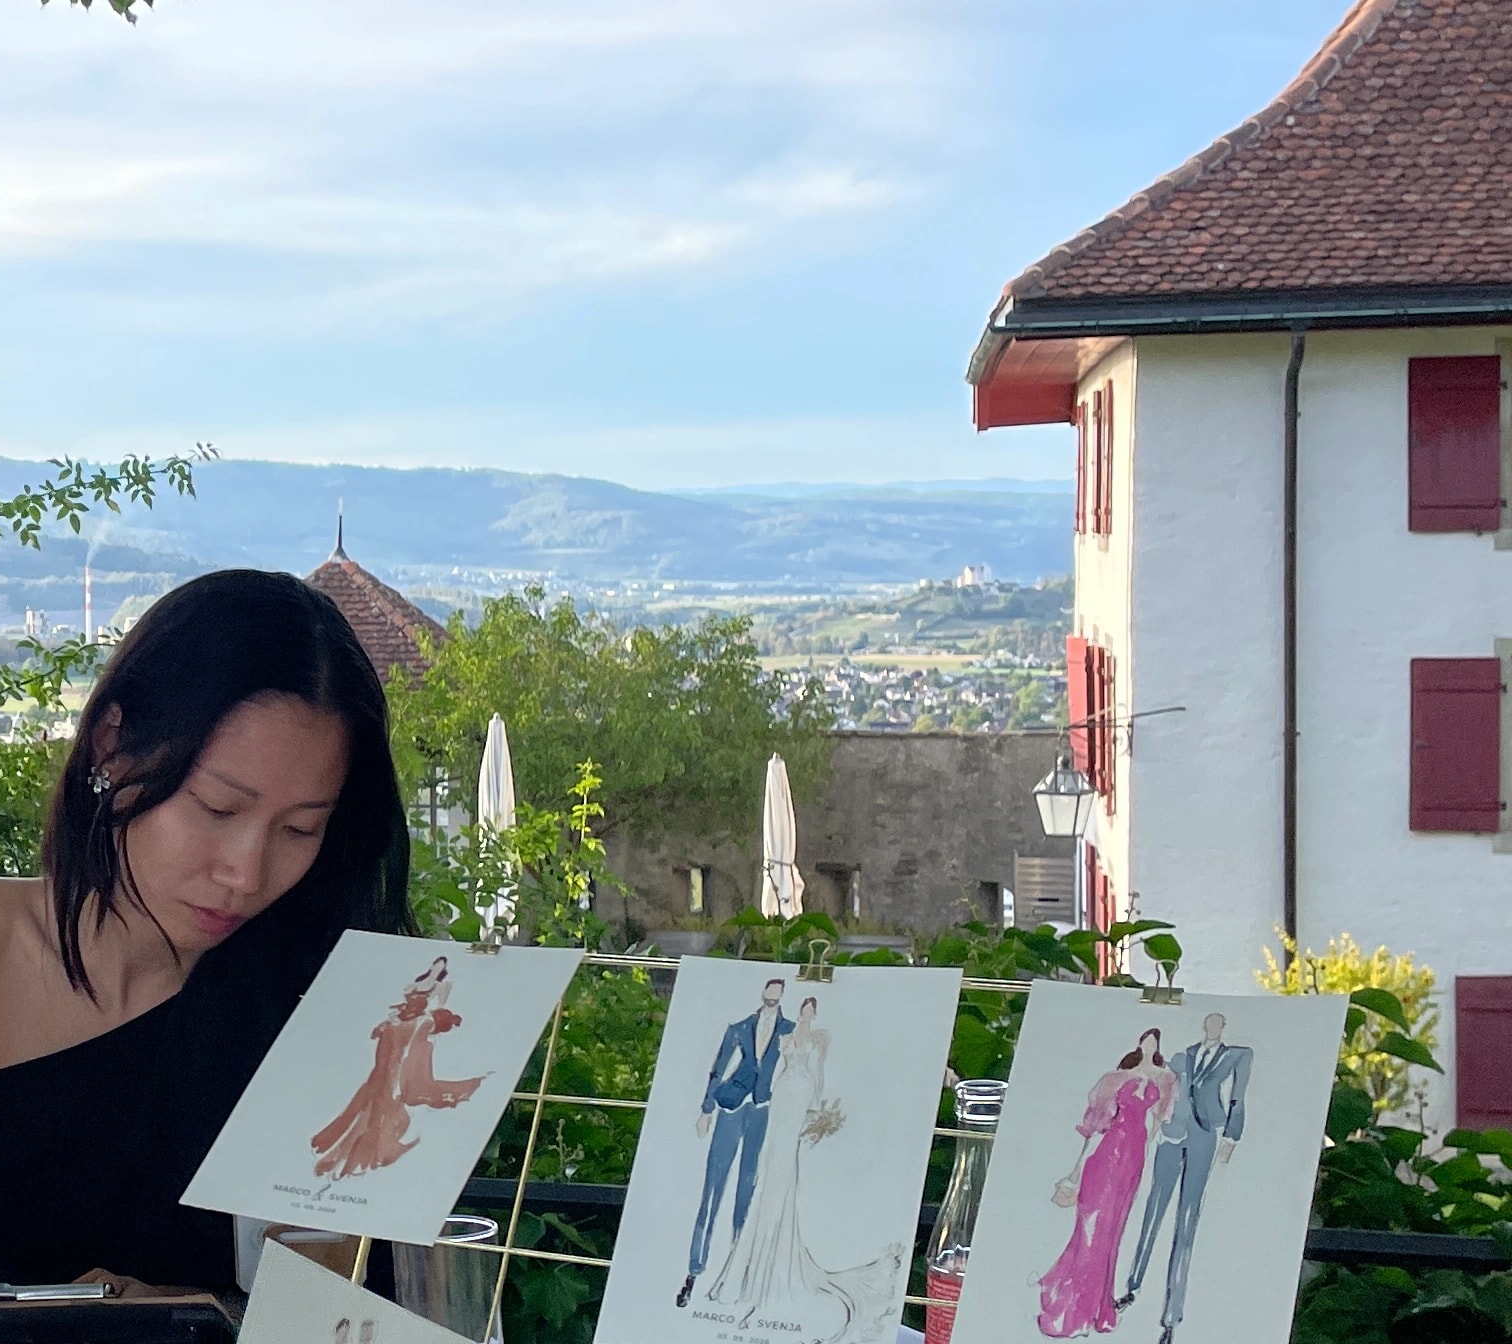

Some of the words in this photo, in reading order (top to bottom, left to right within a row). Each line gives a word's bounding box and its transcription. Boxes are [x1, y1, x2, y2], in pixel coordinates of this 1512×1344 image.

[273, 1183, 311, 1196] MARCO
[311, 1183, 331, 1202] &
[329, 1193, 368, 1205] SVENJA
[692, 1310, 735, 1324] MARCO
[738, 1306, 755, 1330] &
[757, 1319, 802, 1332] SVENJA
